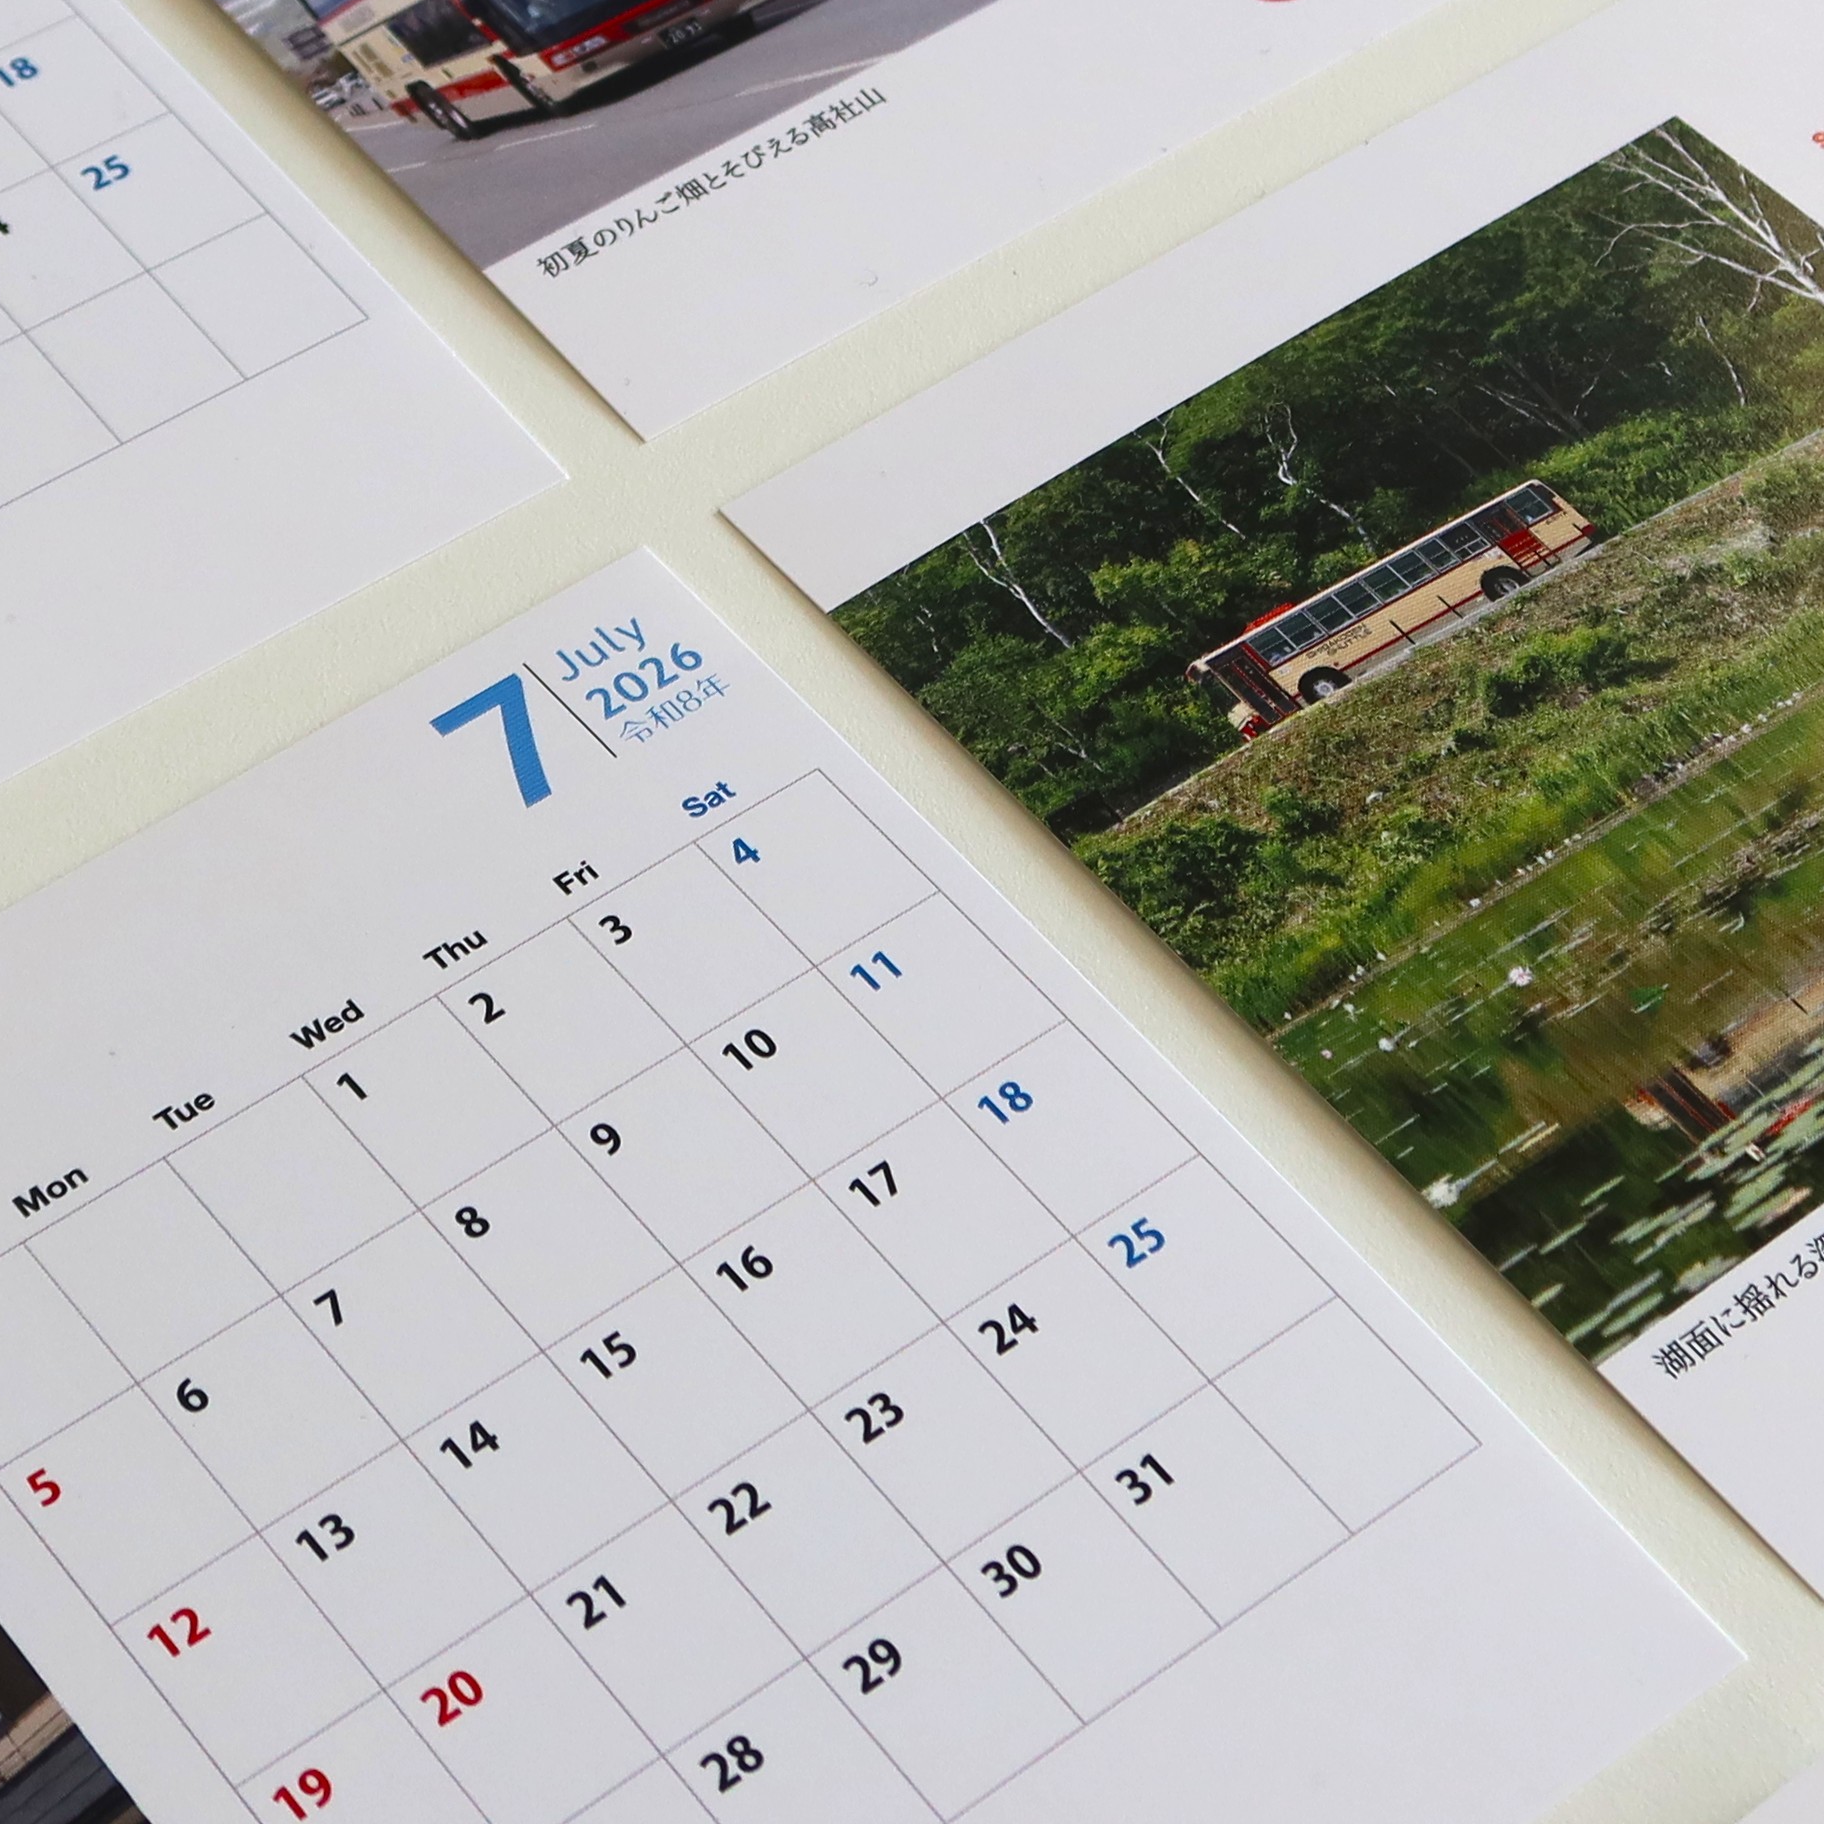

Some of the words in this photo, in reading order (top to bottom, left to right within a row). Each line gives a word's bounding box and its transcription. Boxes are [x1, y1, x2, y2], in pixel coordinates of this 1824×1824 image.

[81, 154, 131, 191] 25
[537, 88, 886, 278] 初夏のりんご畑とそびえる高社山
[429, 673, 552, 808] 7
[556, 618, 645, 681] July
[586, 643, 702, 720] 2026
[620, 674, 729, 742] 令和8年
[10, 1167, 90, 1219] Mon
[150, 1092, 217, 1132] Tue
[288, 997, 366, 1051] Wed
[421, 929, 489, 971] Thu
[551, 863, 601, 897] Fri
[680, 780, 738, 819] Sat
[336, 1072, 368, 1101] 1
[467, 992, 506, 1025] 2
[598, 914, 633, 946] 3
[732, 837, 761, 865] 4
[26, 1468, 62, 1507] 5
[176, 1377, 209, 1413] 6
[313, 1288, 343, 1327] 7
[454, 1206, 491, 1239] 8
[589, 1122, 622, 1156] 9
[721, 1029, 777, 1071] 10
[850, 950, 903, 991] 11
[147, 1607, 212, 1657] 12
[295, 1513, 355, 1562] 13
[439, 1420, 500, 1469] 14
[579, 1330, 637, 1380] 15
[716, 1245, 774, 1292] 16
[848, 1160, 898, 1208] 17
[977, 1081, 1034, 1124] 18
[272, 1768, 332, 1821] 19
[420, 1670, 484, 1727] 20
[566, 1574, 627, 1631] 21
[707, 1482, 772, 1536] 22
[844, 1392, 904, 1445] 23
[977, 1303, 1039, 1356] 24
[1107, 1217, 1166, 1269] 25
[699, 1735, 765, 1794] 28
[842, 1638, 902, 1695] 29
[980, 1544, 1042, 1599] 30
[1114, 1453, 1175, 1506] 31
